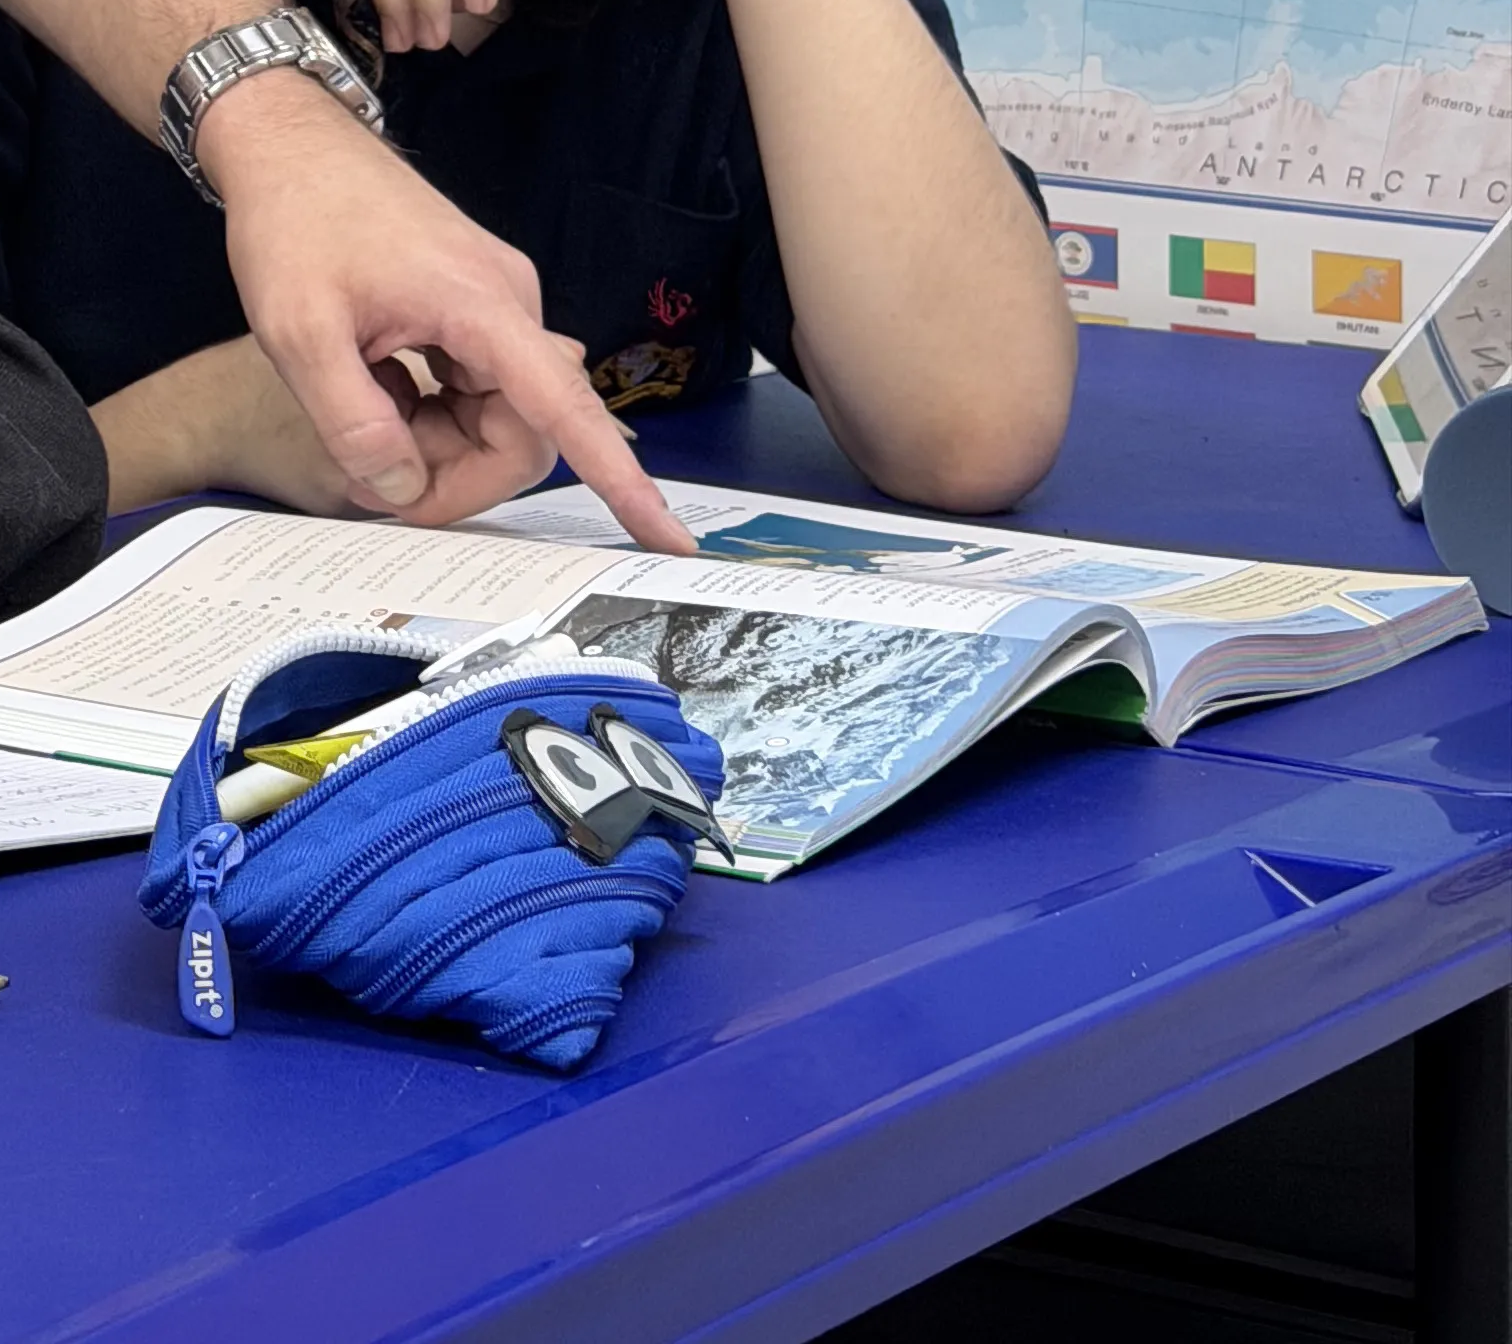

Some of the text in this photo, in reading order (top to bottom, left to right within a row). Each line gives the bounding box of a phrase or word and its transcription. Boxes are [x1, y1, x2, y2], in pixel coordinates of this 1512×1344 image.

[1421, 91, 1483, 118] Enderby
[1227, 136, 1319, 158] Land
[1200, 152, 1508, 206] ANTARCTIC
[1336, 320, 1381, 336] BHUTAN
[191, 930, 222, 1007] zipit
